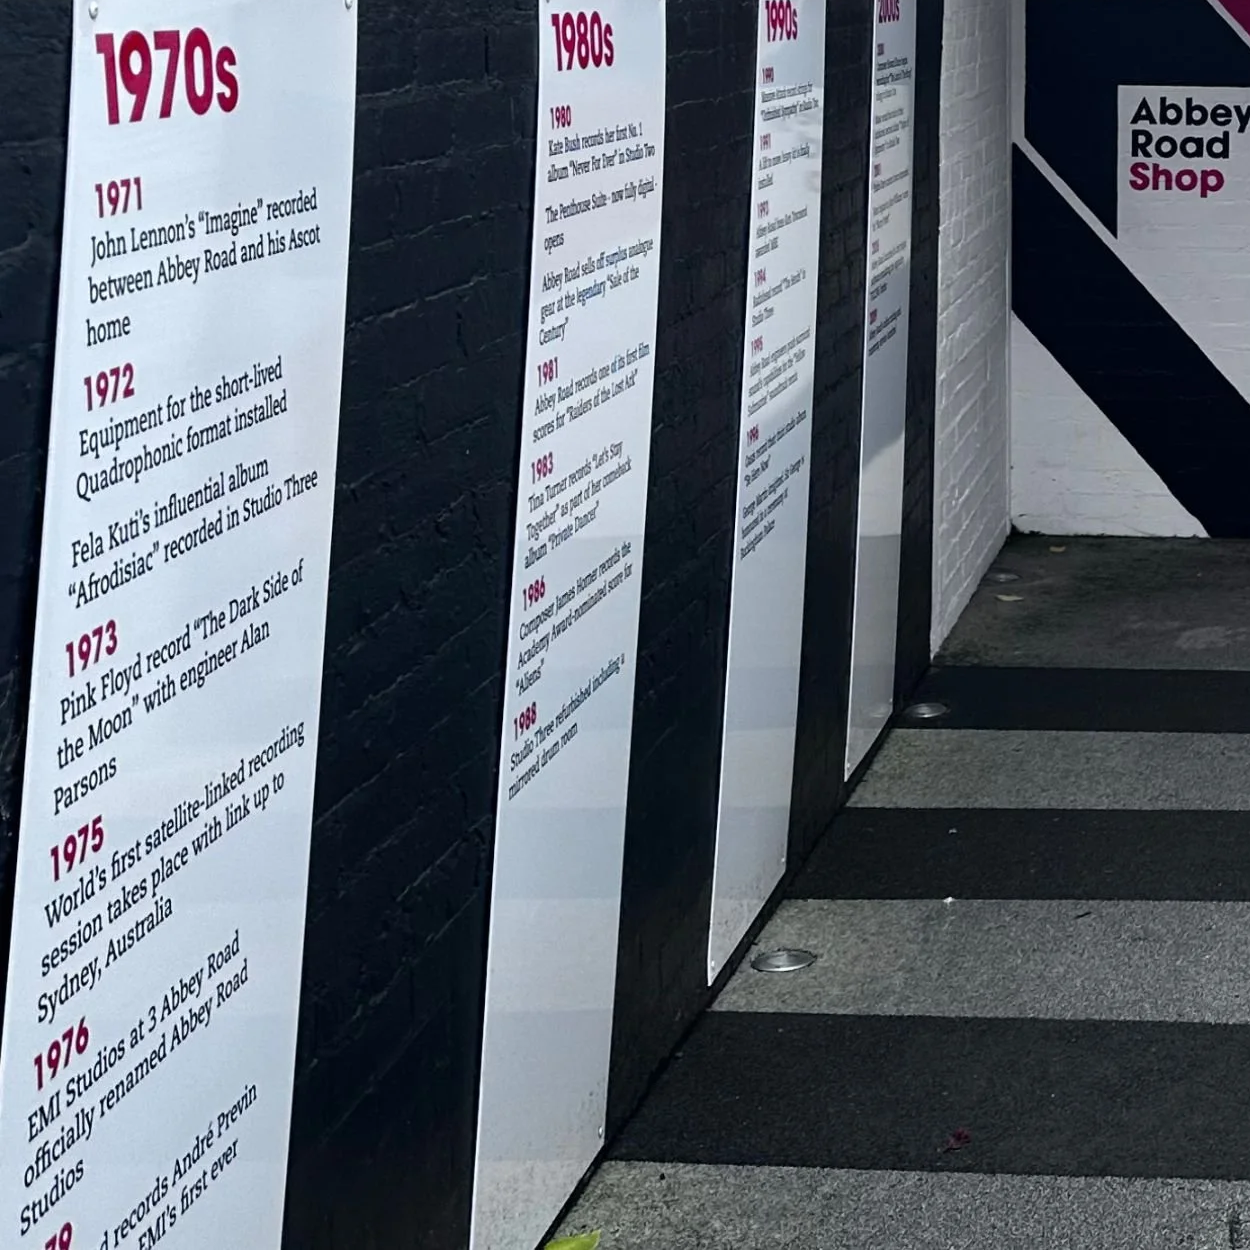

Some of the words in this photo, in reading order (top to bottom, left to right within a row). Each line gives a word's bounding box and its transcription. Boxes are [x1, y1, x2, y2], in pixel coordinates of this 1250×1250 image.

[551, 11, 614, 71] 1980s
[765, 0, 798, 42] 1990s
[95, 27, 239, 125] 1970s
[550, 105, 571, 129] 1980
[1131, 129, 1230, 159] Road
[95, 176, 142, 219] 1971
[1129, 162, 1224, 198] Shop
[88, 269, 154, 304] between
[157, 254, 200, 286] Abbey
[204, 240, 237, 273] Road
[240, 233, 265, 263] and
[267, 230, 286, 256] his
[288, 225, 320, 251] Ascot
[91, 231, 127, 268] John
[266, 187, 318, 221] recorded
[85, 315, 131, 348] home
[79, 404, 164, 460] Equipment
[166, 394, 186, 422] for
[189, 386, 212, 413] the
[215, 355, 282, 403] short-lived
[84, 362, 135, 412] 1972
[537, 356, 557, 386] 1981
[76, 433, 183, 502] Quadrophonic
[186, 415, 232, 453] format
[234, 388, 287, 433] installed
[531, 451, 553, 484] 1983
[71, 531, 104, 568] Fela
[154, 471, 225, 528] influential
[228, 459, 269, 493] album
[164, 509, 223, 563] recorded
[226, 505, 240, 531] in
[243, 484, 282, 522] Studio
[284, 471, 318, 500] Three
[522, 575, 545, 611] 1986
[60, 681, 97, 726] Pink
[101, 652, 142, 701] Floyd
[146, 623, 191, 674] record
[229, 586, 260, 624] Dark
[263, 571, 289, 604] Side
[291, 558, 304, 586] of
[66, 619, 118, 678] 1973
[57, 737, 84, 770] the
[143, 674, 176, 713] with
[180, 640, 238, 691] engineer
[240, 621, 270, 654] Alan
[513, 701, 536, 740] 1988
[53, 757, 117, 816] Parsons
[111, 840, 142, 881] first
[145, 758, 245, 855] satellite-linked
[248, 722, 304, 778] recording
[41, 913, 103, 977] session
[107, 878, 147, 924] takes
[151, 846, 189, 898] place
[191, 816, 223, 856] with
[225, 794, 250, 831] link
[253, 784, 269, 810] up
[272, 772, 284, 794] to
[50, 815, 104, 882] 1975
[38, 956, 102, 1024] Sydney,
[105, 895, 173, 968] Australia
[24, 1106, 95, 1188] officially
[99, 1032, 167, 1118] renamed
[170, 997, 213, 1052] Abbey
[216, 958, 248, 1008] Road
[28, 1089, 61, 1143] EMI
[66, 1039, 125, 1108] Studios
[130, 1019, 145, 1049] at
[148, 1006, 157, 1033] 3
[160, 968, 204, 1023] Abbey
[207, 929, 240, 979] Road
[34, 1016, 89, 1091] 1976
[20, 1159, 84, 1237] Studios
[114, 1177, 168, 1248] records
[172, 1121, 214, 1186] André
[217, 1083, 258, 1139] Previn
[181, 1172, 208, 1216] first
[210, 1138, 239, 1179] ever
